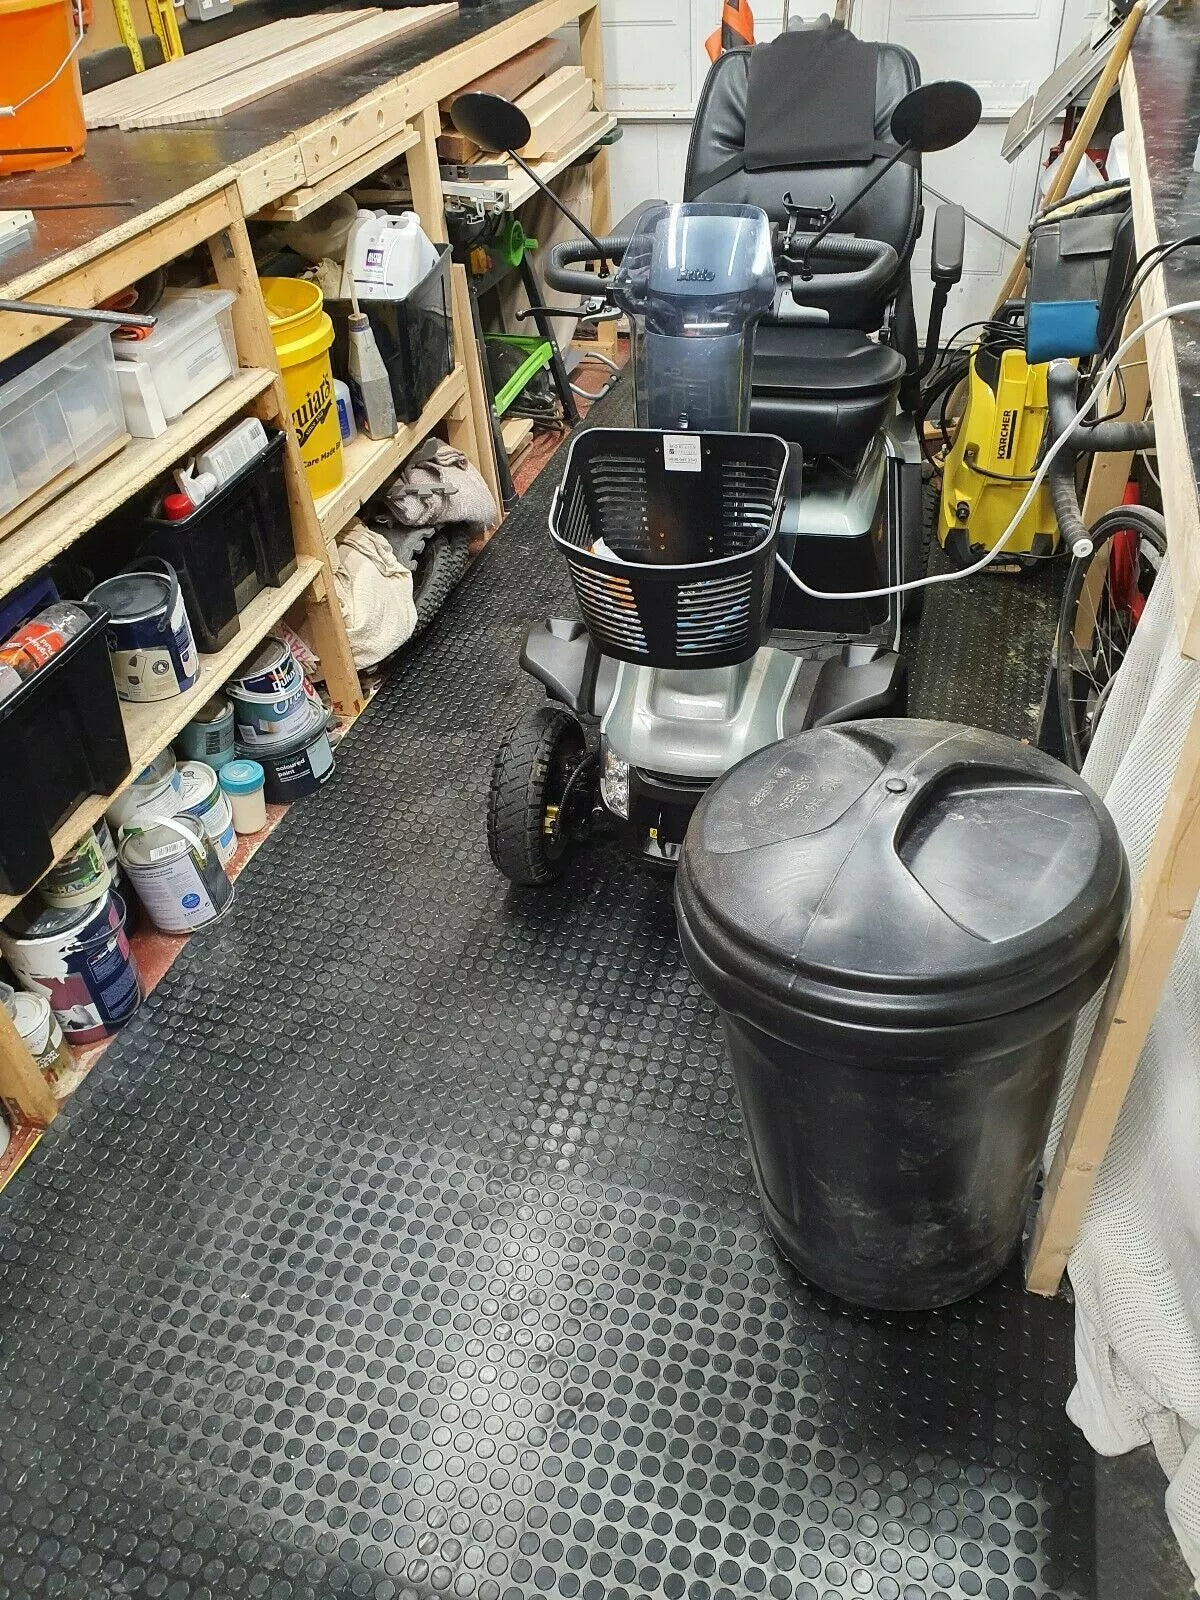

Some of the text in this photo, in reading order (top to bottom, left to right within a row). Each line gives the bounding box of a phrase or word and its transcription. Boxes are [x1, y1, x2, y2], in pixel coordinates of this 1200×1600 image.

[677, 268, 716, 282] Pride
[275, 758, 306, 772] coloured
[277, 769, 296, 779] paint
